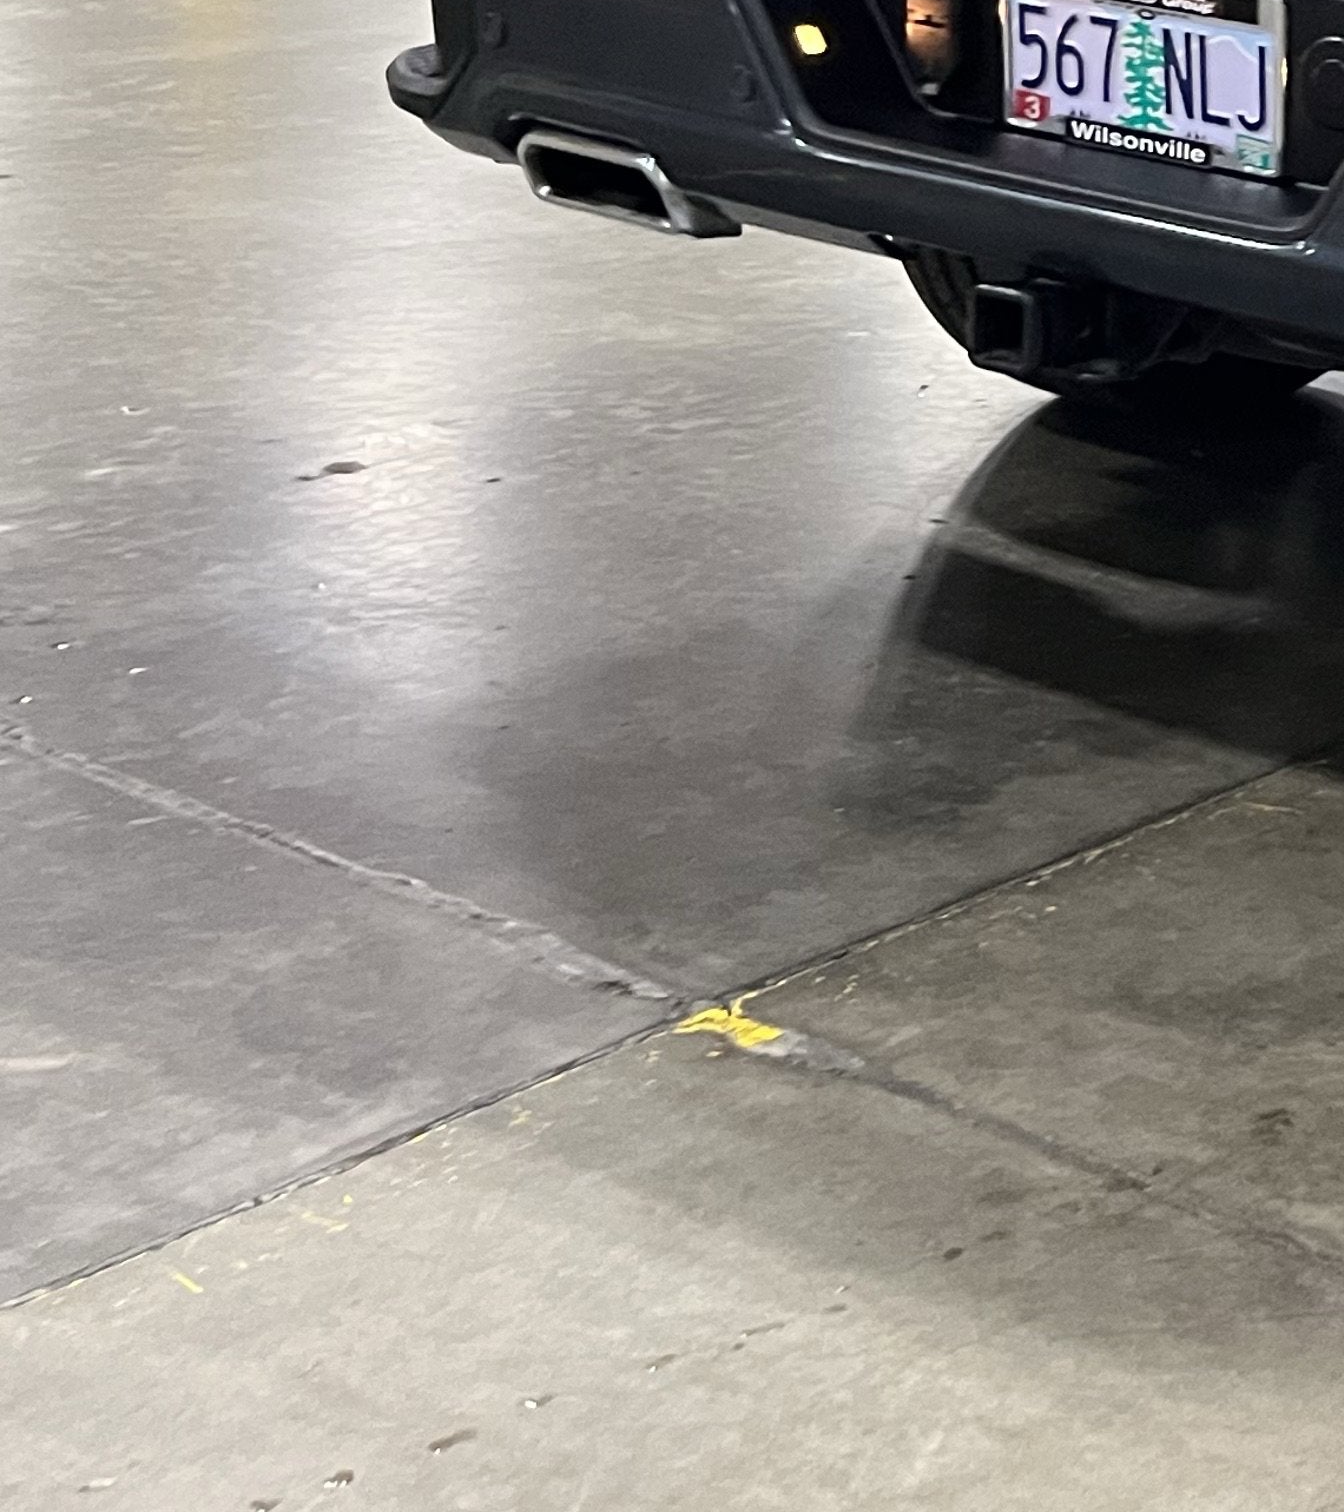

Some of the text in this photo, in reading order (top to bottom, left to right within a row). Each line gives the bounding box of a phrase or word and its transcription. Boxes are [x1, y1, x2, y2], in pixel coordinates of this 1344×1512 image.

[1018, 3, 1267, 132] 567 NLJ
[1023, 96, 1042, 120] 3
[1070, 120, 1207, 164] Wilsonville
